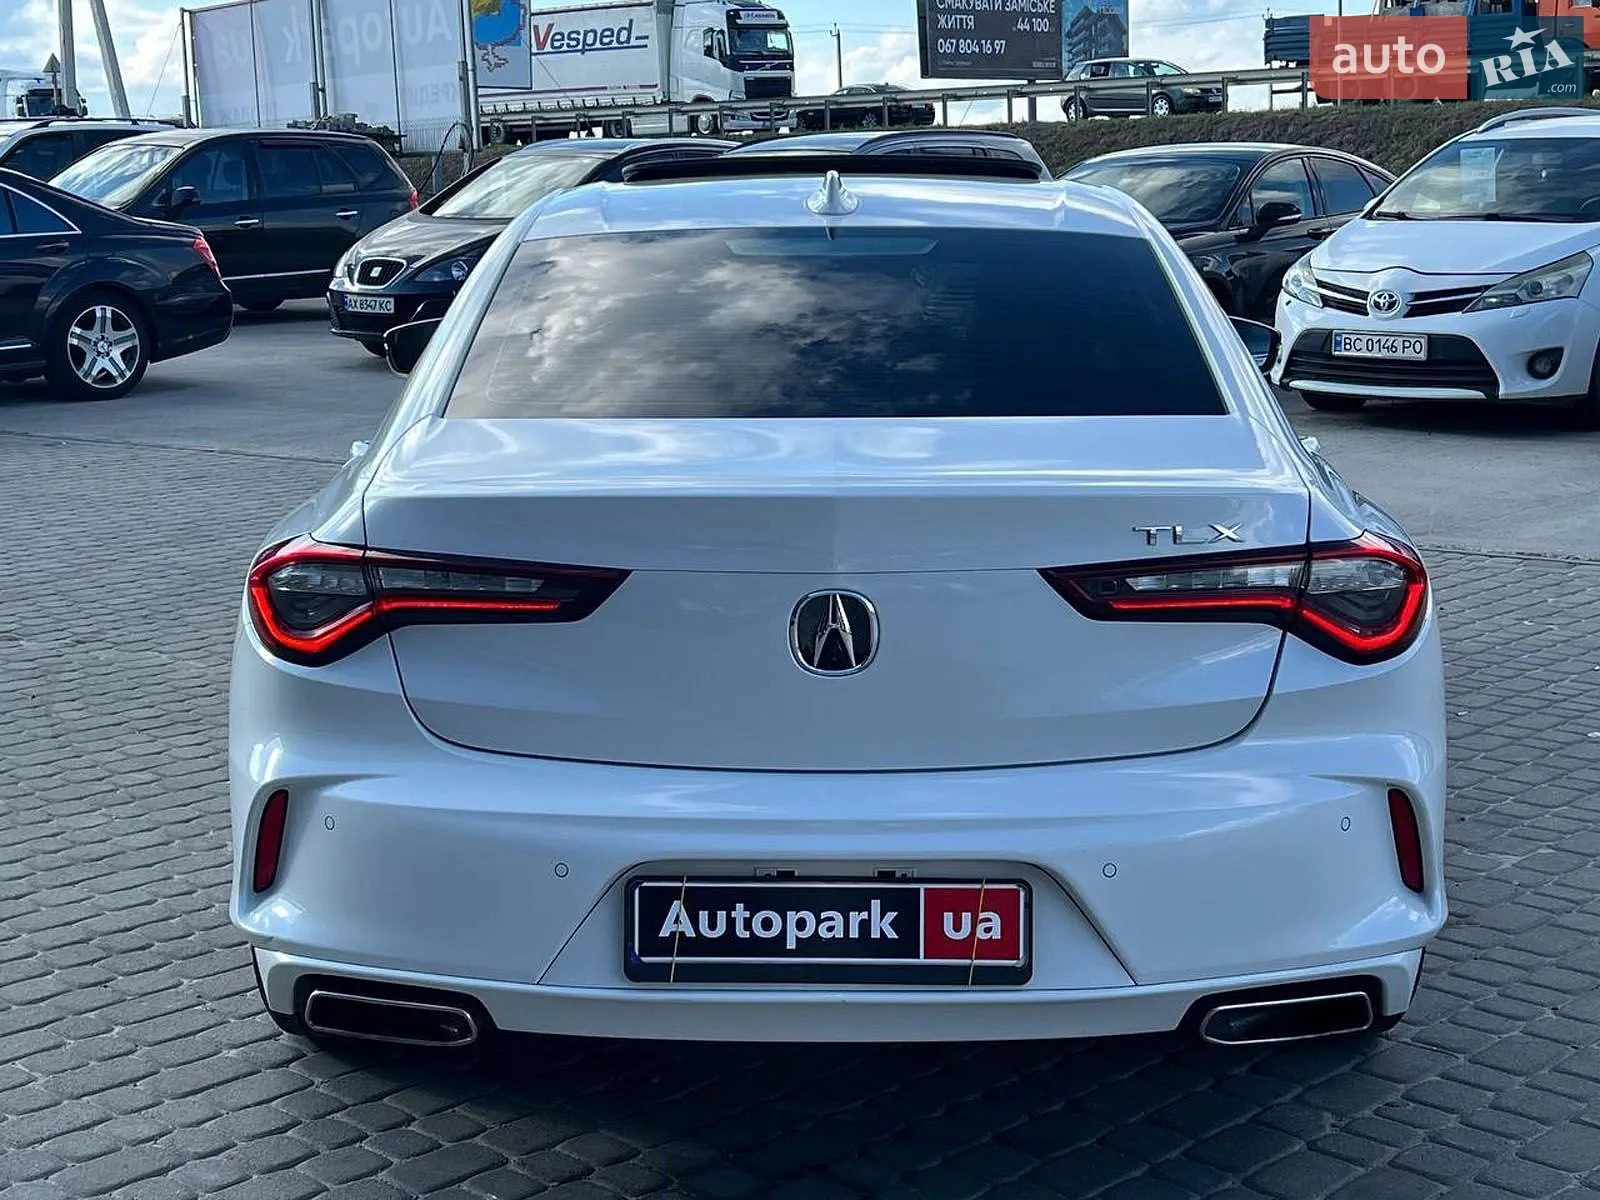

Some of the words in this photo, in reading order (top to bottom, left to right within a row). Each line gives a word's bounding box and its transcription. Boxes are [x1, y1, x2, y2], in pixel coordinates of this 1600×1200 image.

[1004, 0, 1056, 13] ЗАМІСЬКЕ
[937, 14, 975, 30] ЖИТТЯ
[1017, 18, 1031, 32] 44
[1032, 18, 1050, 32] 100
[533, 18, 633, 55] Vesped
[937, 38, 956, 54] 067
[959, 39, 980, 54] 804
[981, 39, 992, 54] 16
[994, 40, 1006, 54] 97
[1343, 337, 1362, 352] BC
[1366, 338, 1398, 353] 0146
[1402, 339, 1423, 354] PO
[1132, 522, 1245, 546] TLX
[658, 900, 899, 950] Autopark
[943, 910, 1002, 940] ua
